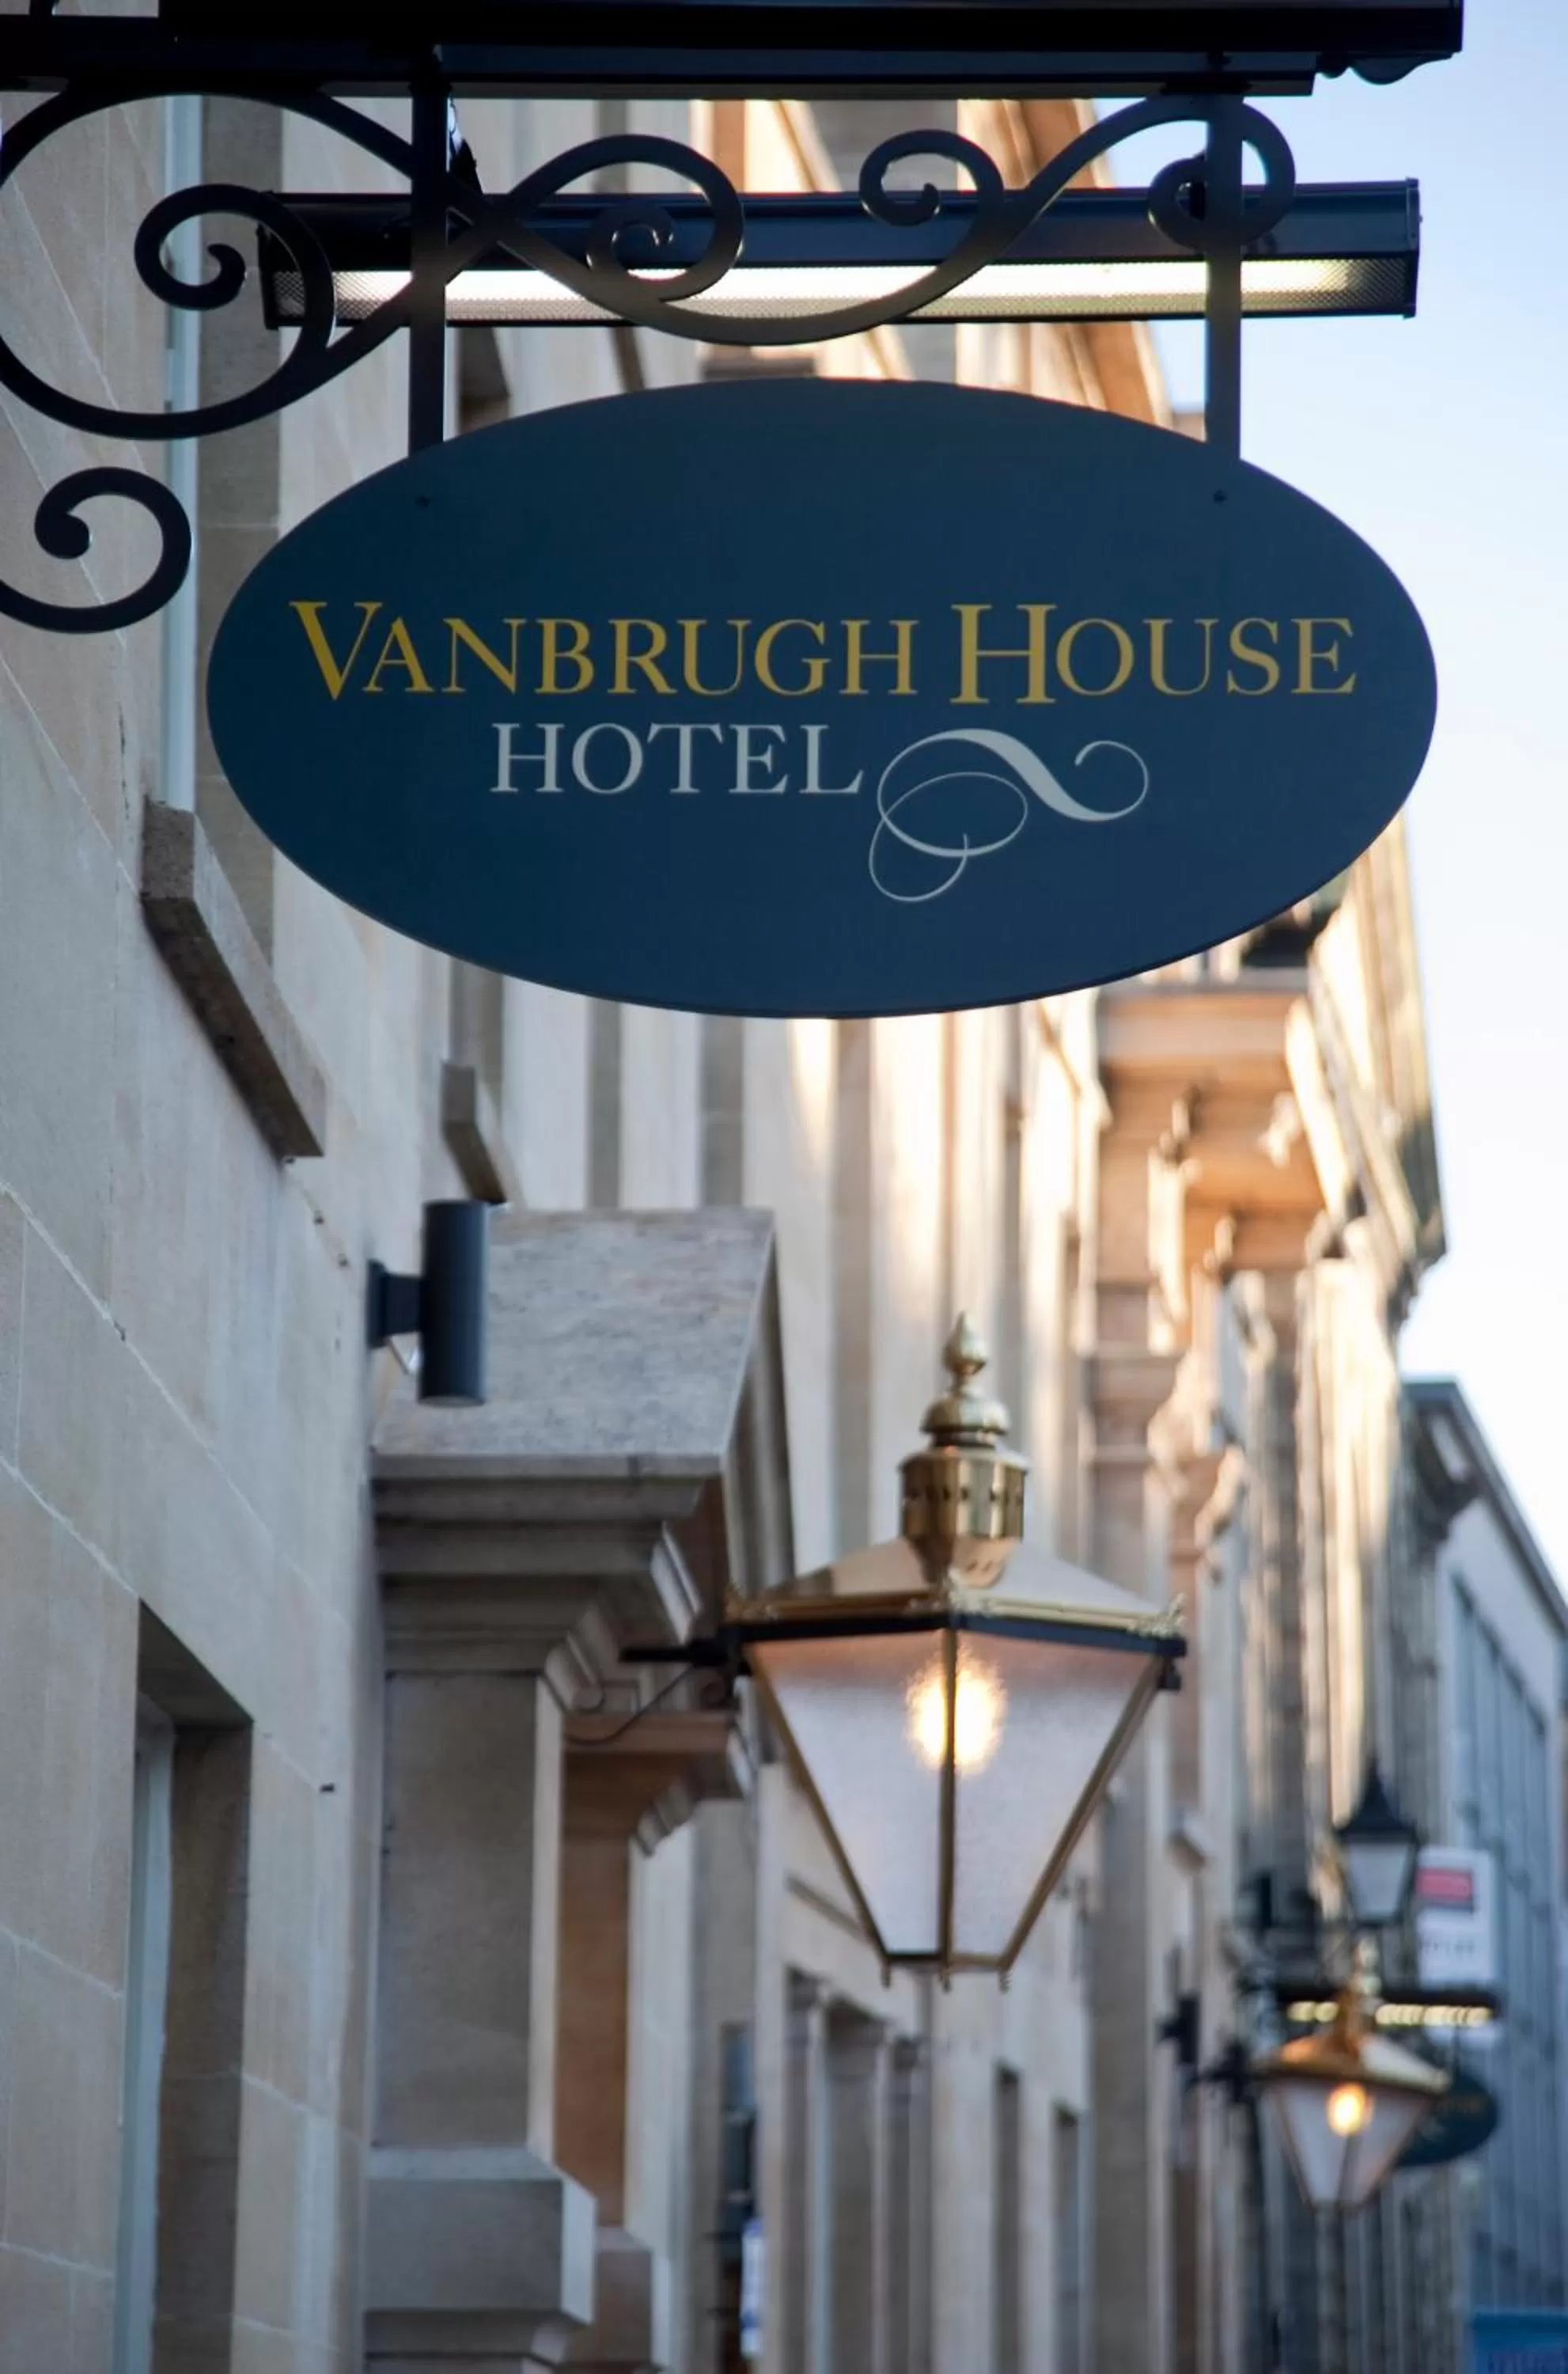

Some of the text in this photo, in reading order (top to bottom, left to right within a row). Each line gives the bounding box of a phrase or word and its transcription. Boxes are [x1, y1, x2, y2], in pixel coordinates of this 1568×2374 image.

[289, 601, 1357, 704] VANBRUGH HOUSE
[490, 722, 865, 794] HOTEL
